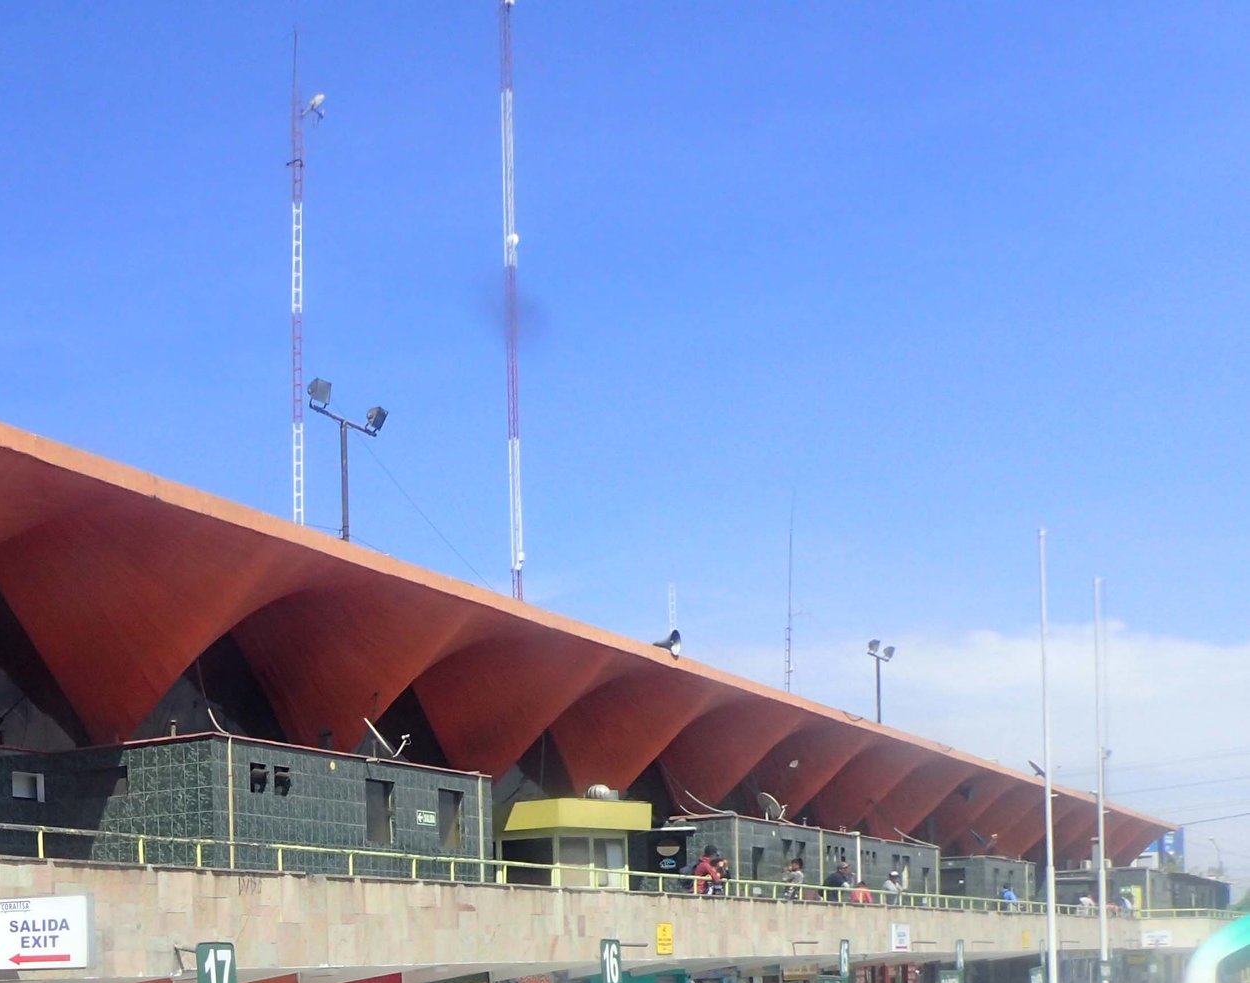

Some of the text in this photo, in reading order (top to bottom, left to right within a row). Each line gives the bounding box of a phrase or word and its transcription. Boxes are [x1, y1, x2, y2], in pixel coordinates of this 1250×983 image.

[9, 918, 70, 933] SALIDA
[21, 935, 59, 949] EXIT
[603, 943, 619, 983] 16
